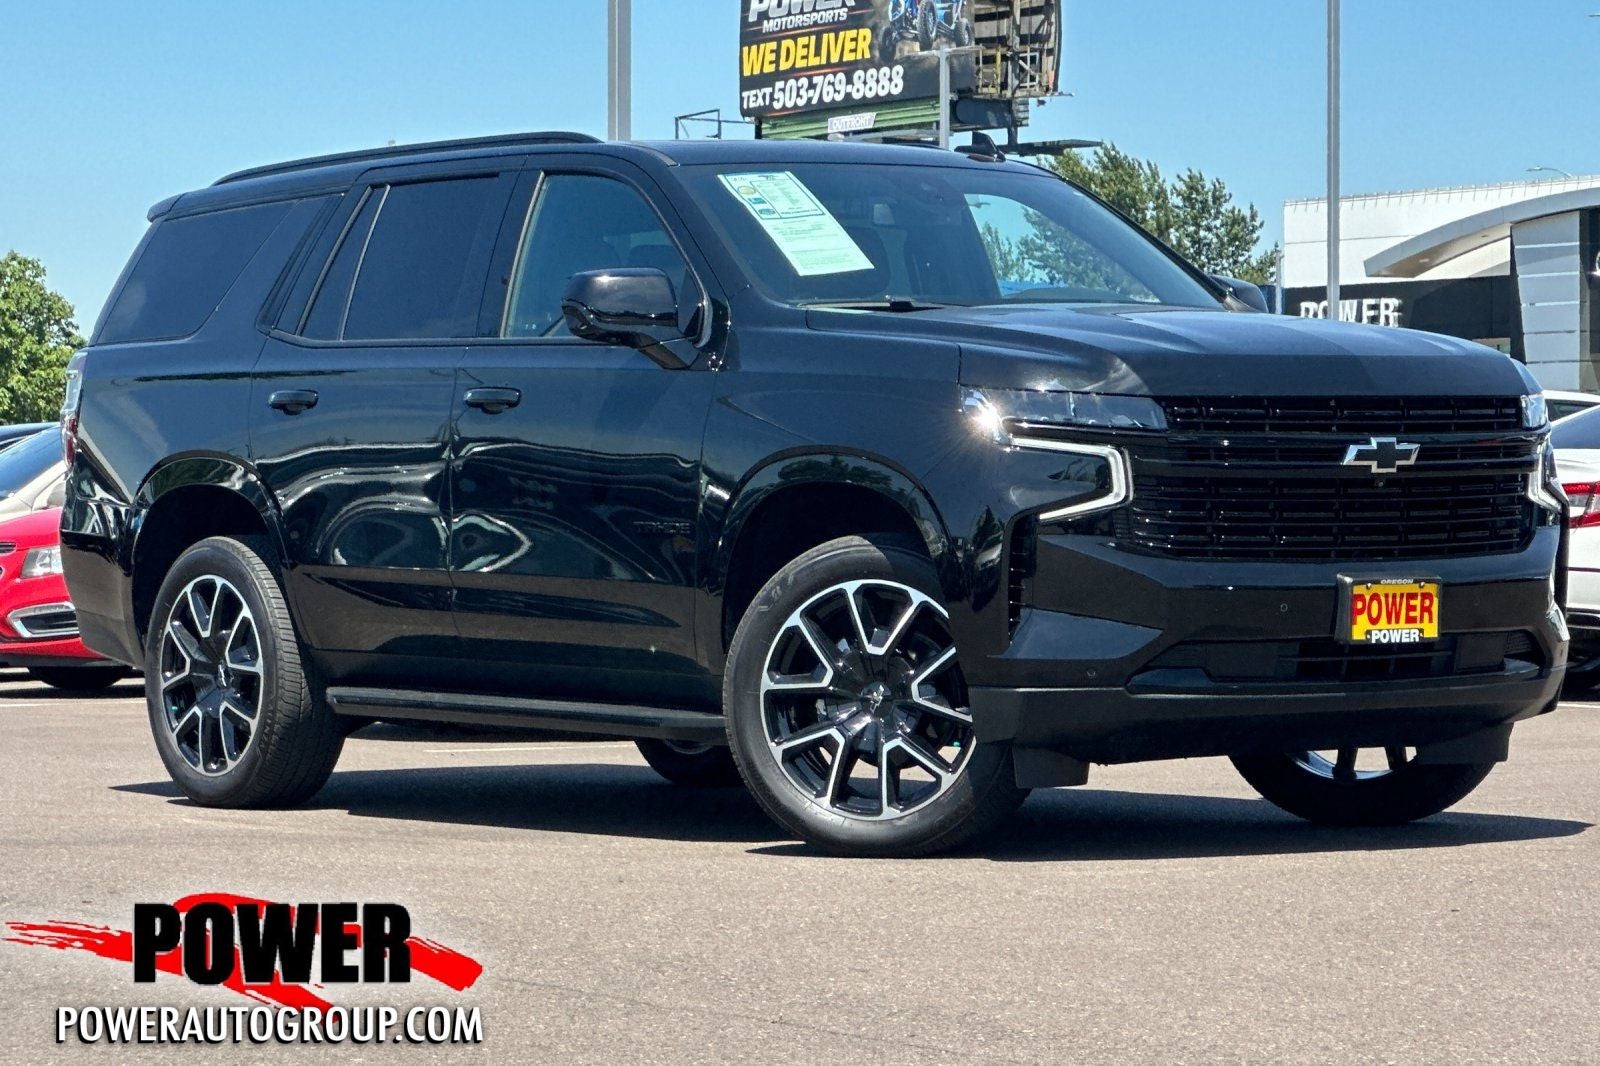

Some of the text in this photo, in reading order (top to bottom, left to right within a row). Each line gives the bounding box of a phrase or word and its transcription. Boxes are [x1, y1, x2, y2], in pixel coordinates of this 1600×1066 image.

[762, 7, 848, 33] MOTORSPORTS
[742, 28, 871, 77] WE DELIVER
[741, 65, 904, 109] TEXT 503-769-8888
[1352, 592, 1434, 625] POWER
[1371, 629, 1420, 643] POWER
